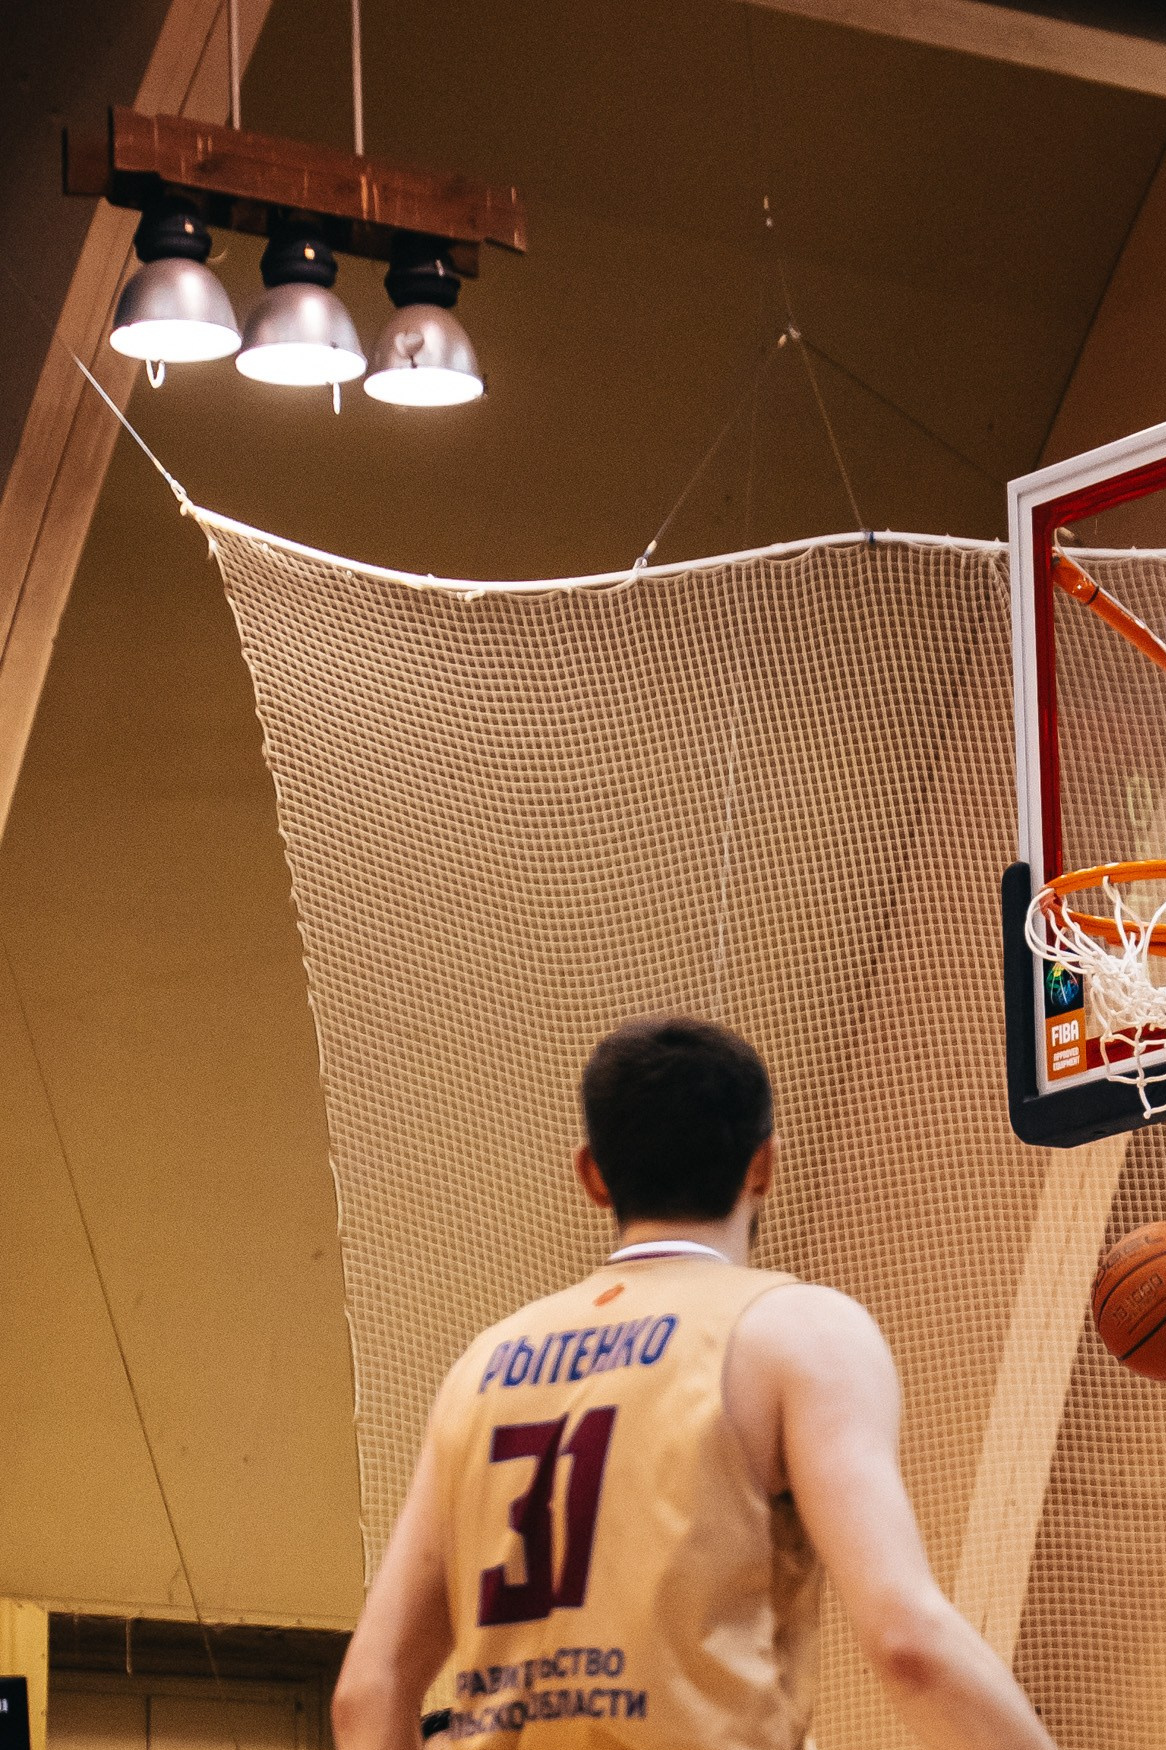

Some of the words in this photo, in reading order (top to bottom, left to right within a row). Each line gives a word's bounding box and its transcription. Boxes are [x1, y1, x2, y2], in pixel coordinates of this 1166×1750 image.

[1051, 1020, 1079, 1047] FIBA
[478, 1313, 680, 1394] РЫТЕНКО
[477, 1404, 618, 1627] 31
